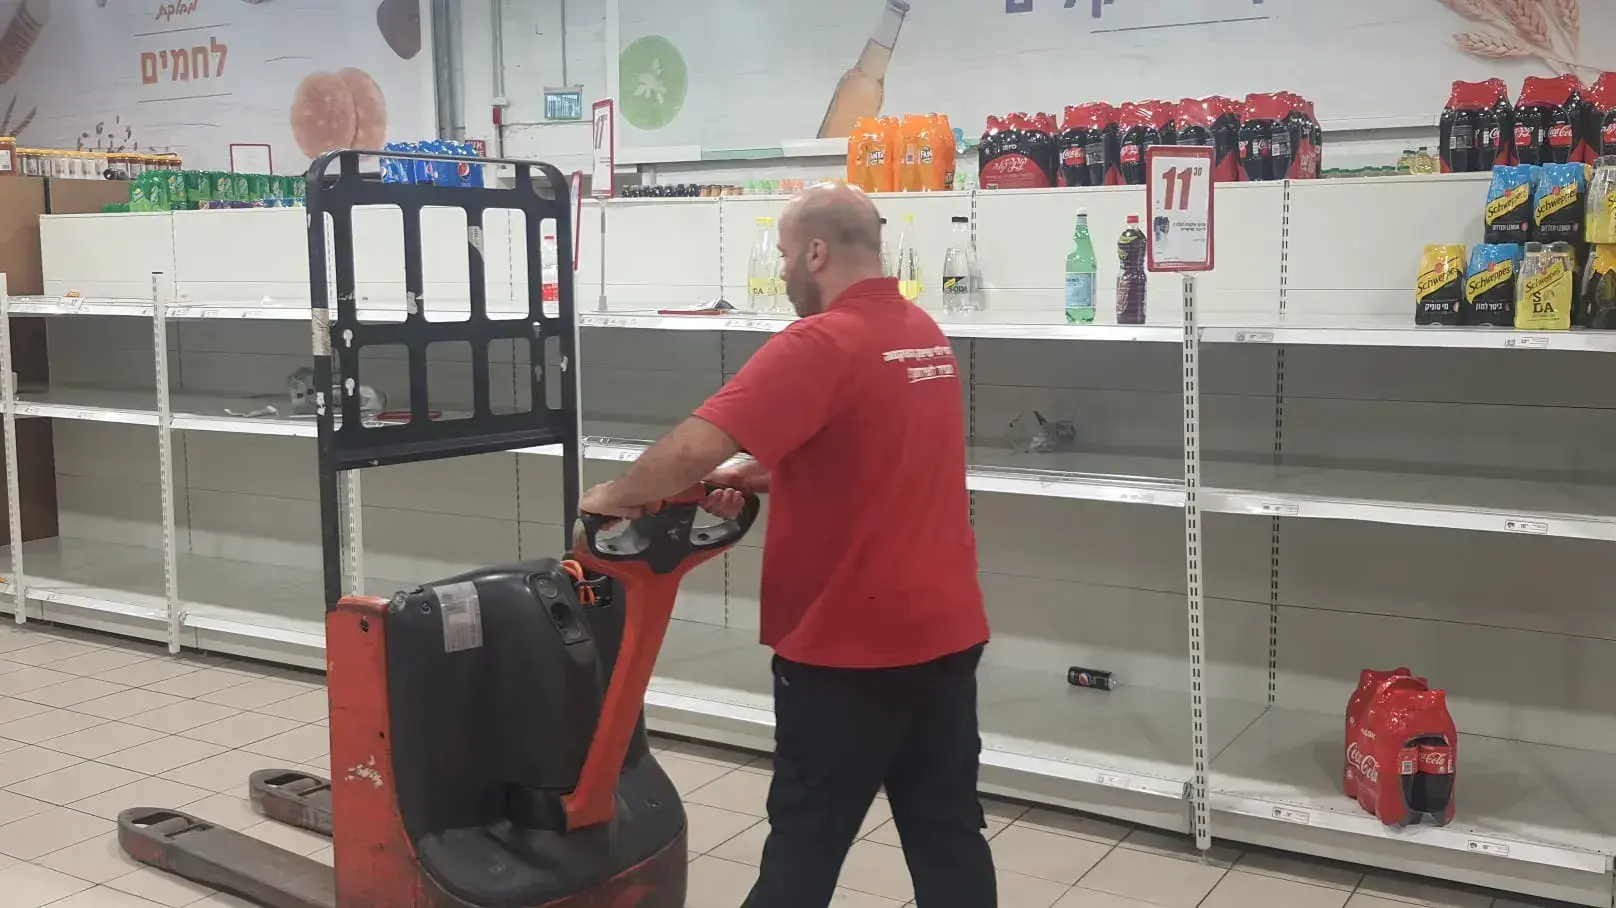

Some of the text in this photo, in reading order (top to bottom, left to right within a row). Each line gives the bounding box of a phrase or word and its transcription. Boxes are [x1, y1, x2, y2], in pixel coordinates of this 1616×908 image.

[140, 36, 228, 85] לחמים
[1162, 166, 1193, 210] 11
[1468, 266, 1511, 295] Schweppes
